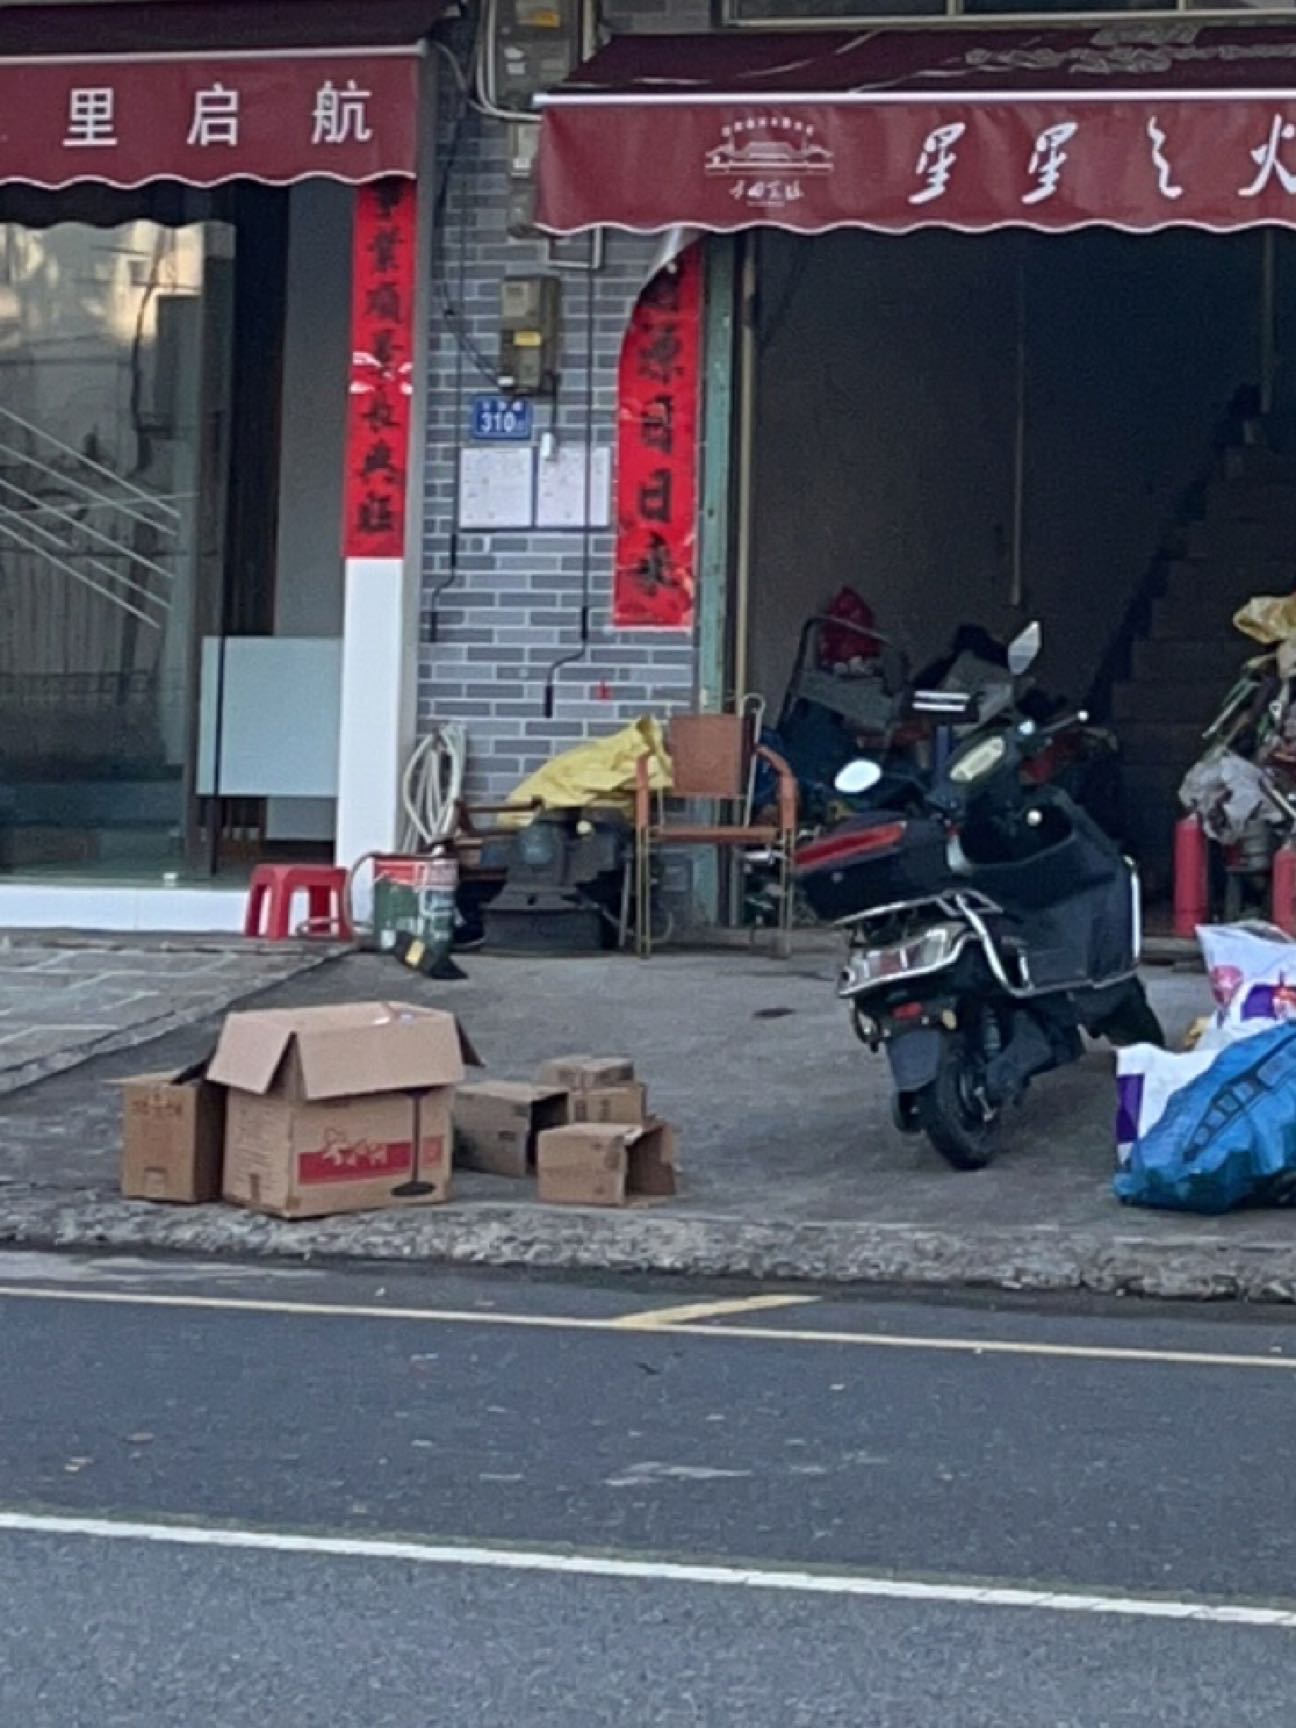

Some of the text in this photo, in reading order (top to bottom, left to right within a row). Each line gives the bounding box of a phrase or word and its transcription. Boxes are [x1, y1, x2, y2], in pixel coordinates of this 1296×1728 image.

[62, 80, 374, 148] 里启航
[481, 411, 516, 432] 310
